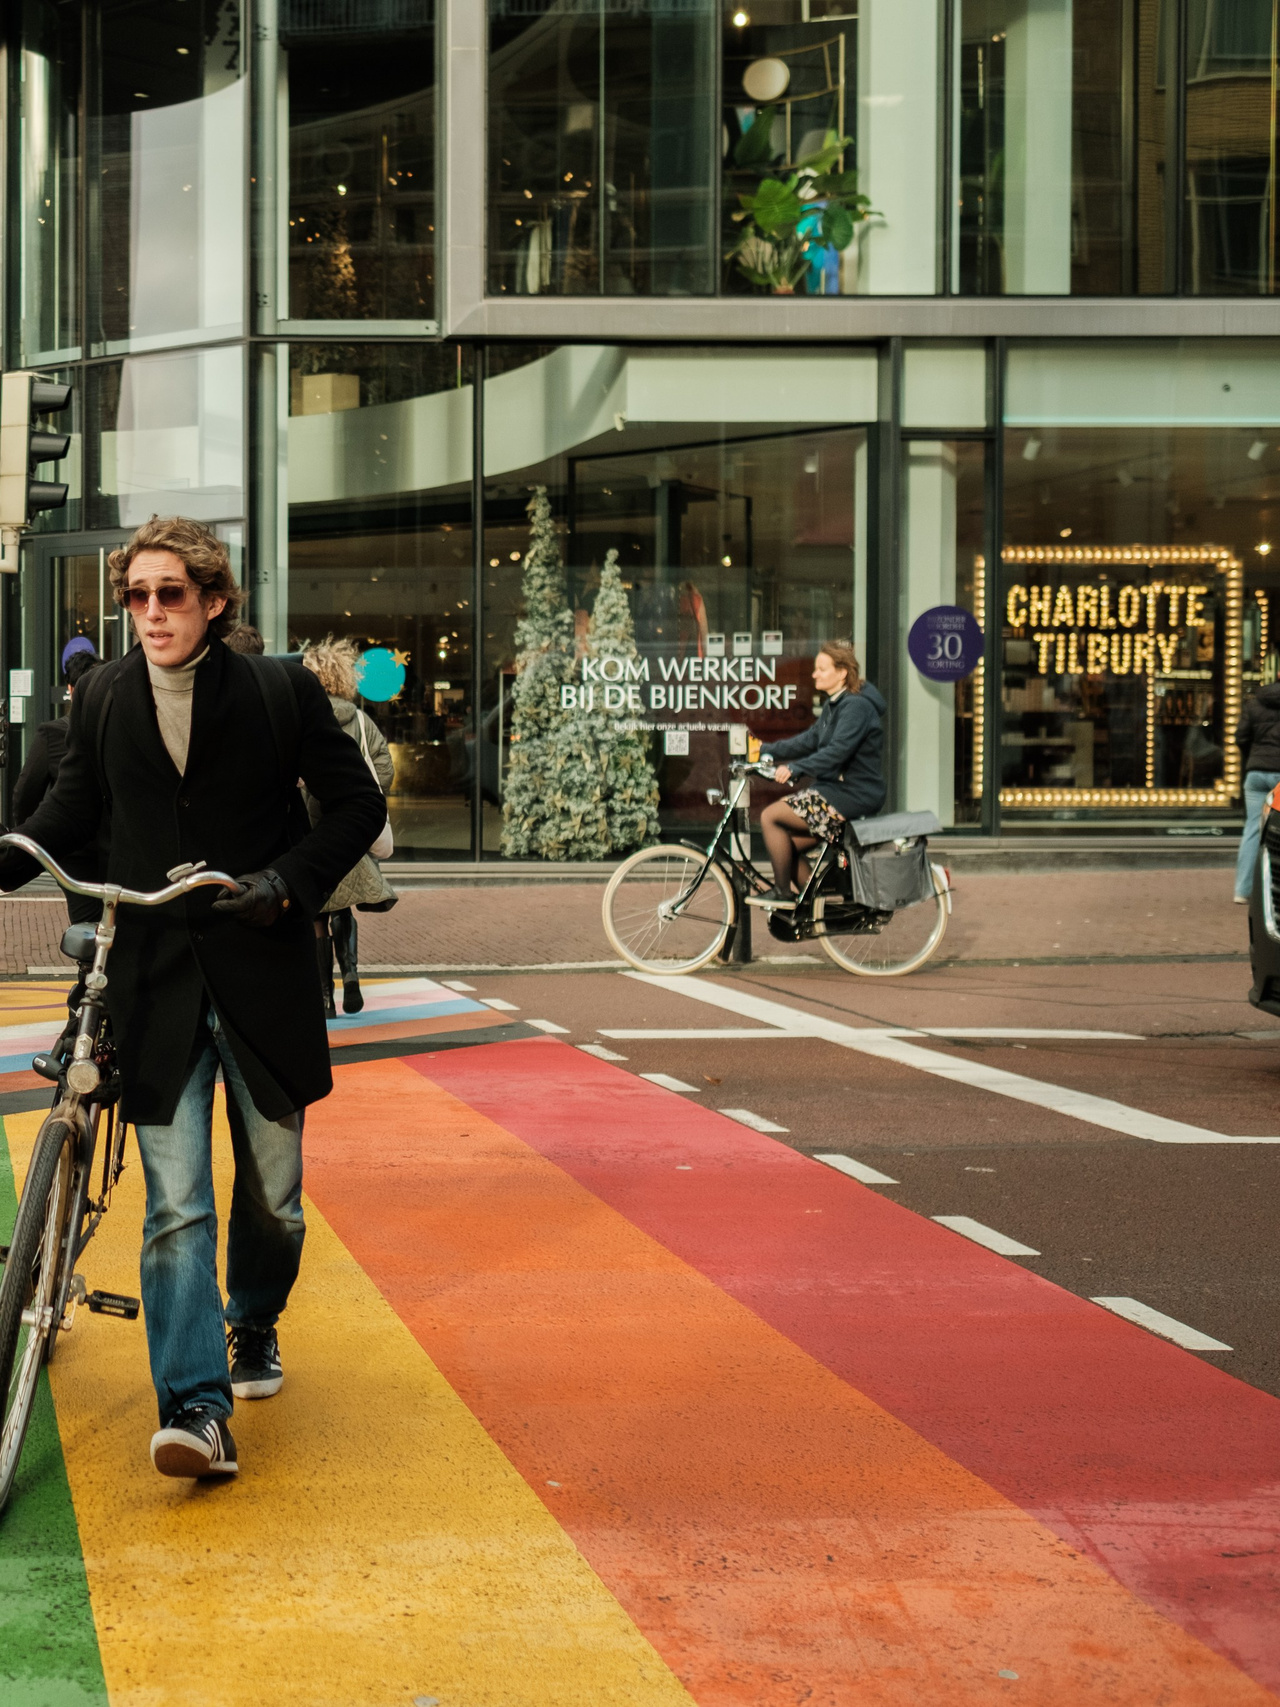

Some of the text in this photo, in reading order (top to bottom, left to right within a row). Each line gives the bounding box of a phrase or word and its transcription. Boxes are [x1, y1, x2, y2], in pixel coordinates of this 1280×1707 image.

[1006, 584, 1208, 628] CHARLOTTE
[927, 632, 962, 660] 30
[1033, 632, 1179, 675] TILBURY
[581, 656, 776, 682] KOM WERKEN
[561, 684, 797, 713] BIJ DE BIJENKORF
[656, 723, 676, 731] onze
[678, 721, 706, 731] actuele
